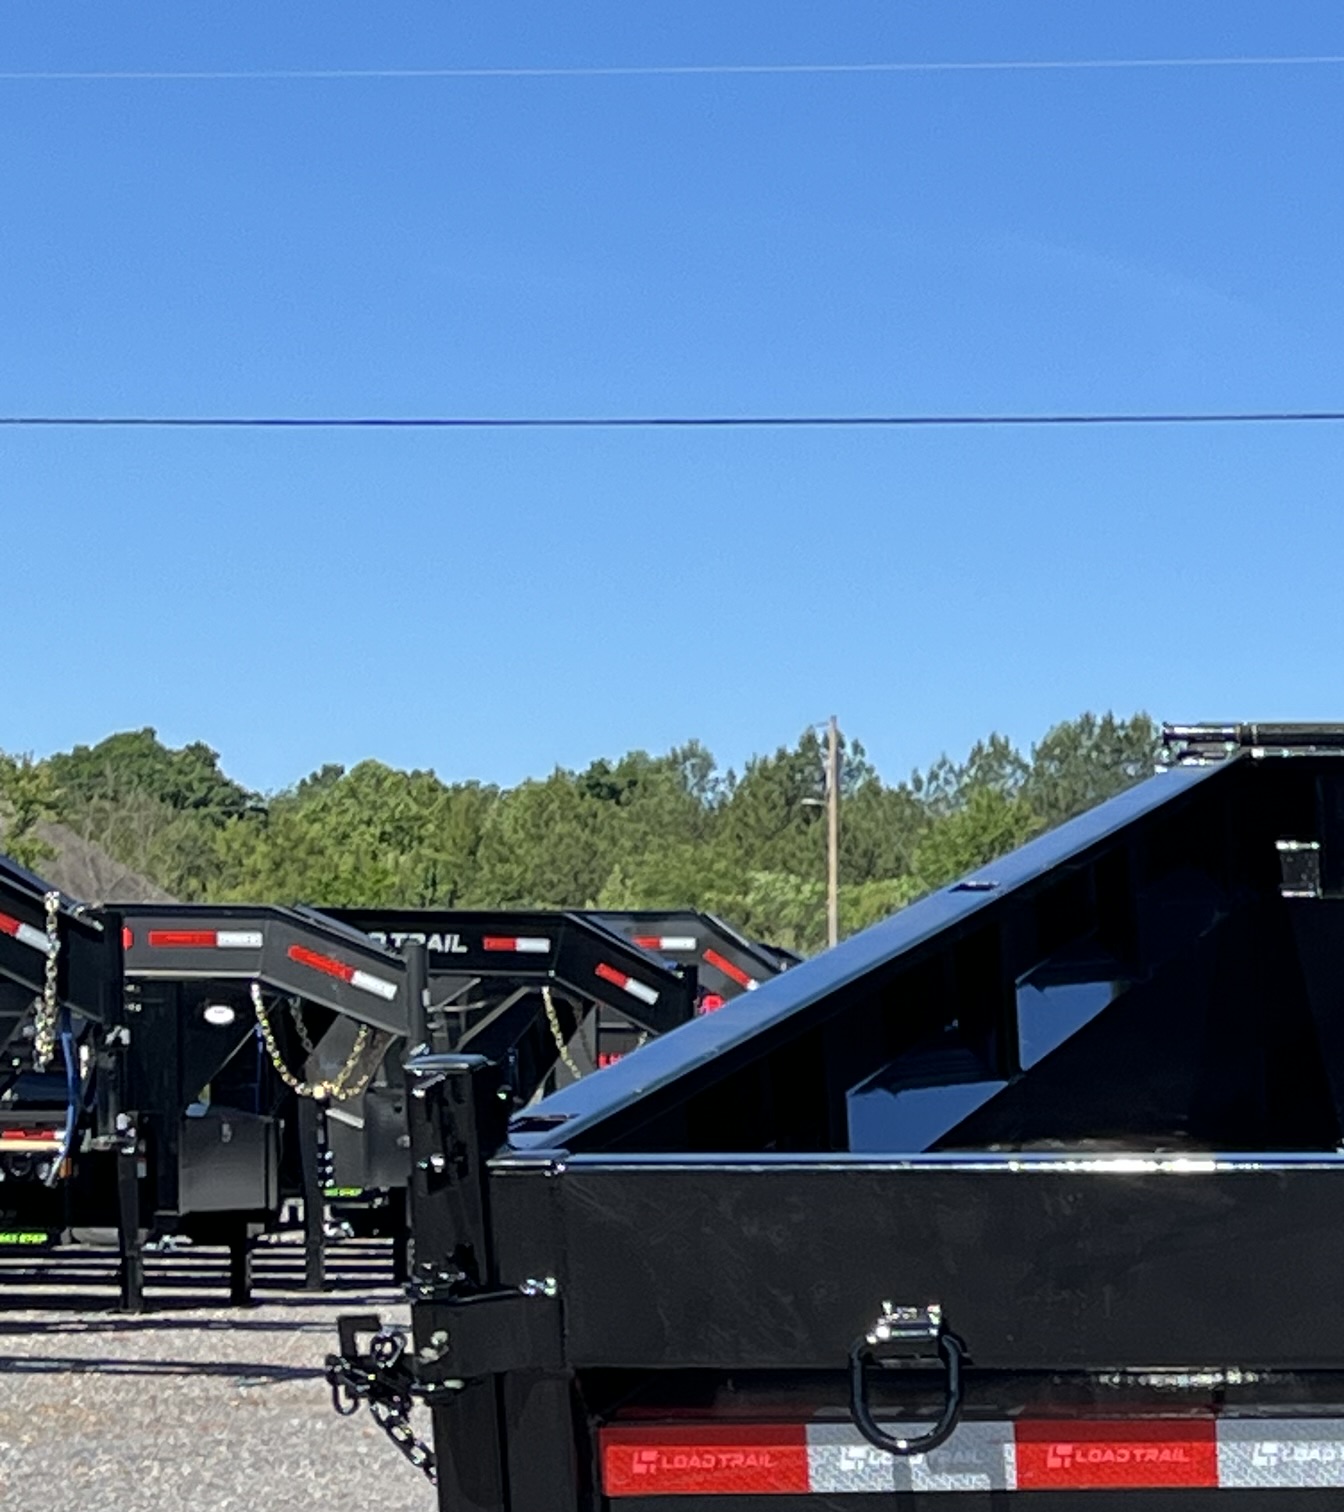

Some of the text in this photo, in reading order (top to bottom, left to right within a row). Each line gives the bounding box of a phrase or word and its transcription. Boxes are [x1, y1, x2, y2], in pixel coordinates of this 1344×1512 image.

[661, 1453, 778, 1469] LOAD TRAIL
[1075, 1448, 1190, 1463] LOAD TRAIL
